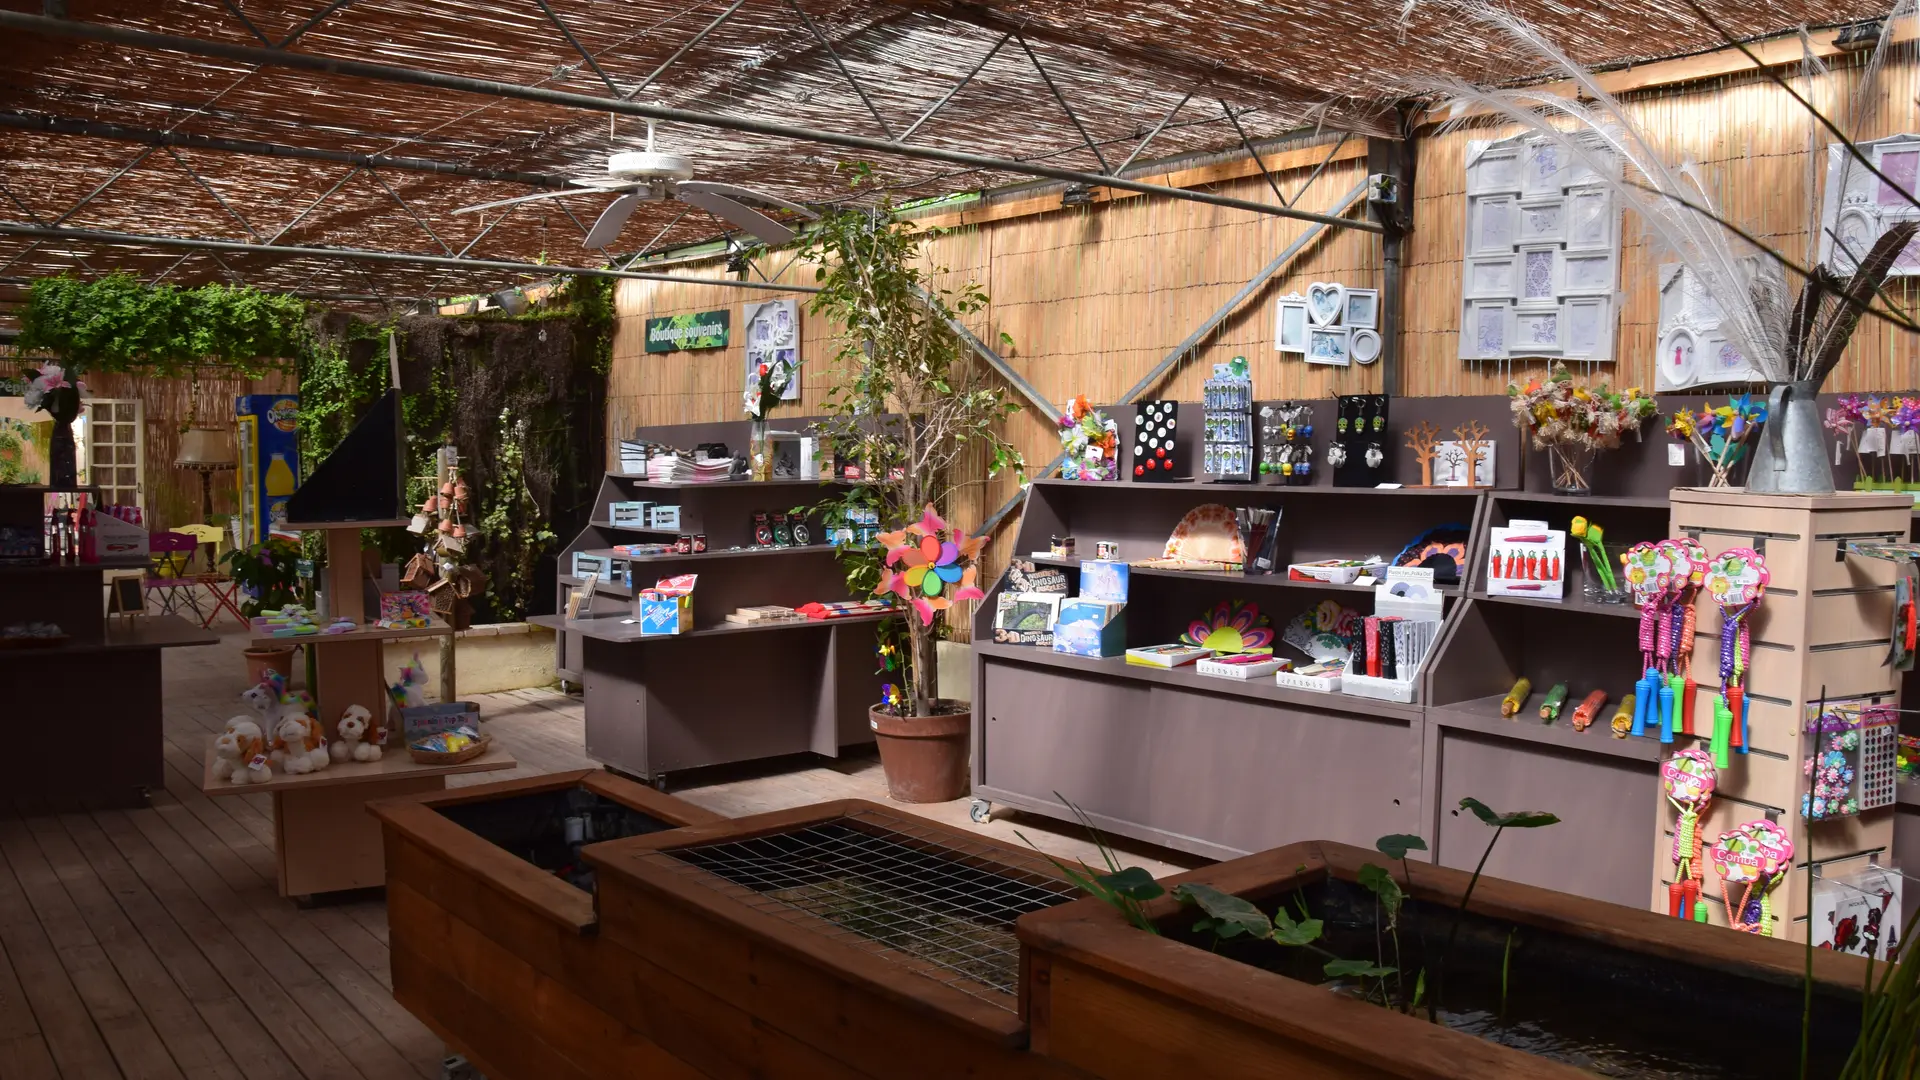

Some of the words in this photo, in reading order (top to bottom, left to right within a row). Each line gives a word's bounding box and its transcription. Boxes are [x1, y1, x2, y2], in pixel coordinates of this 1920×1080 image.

[650, 326, 683, 344] Boutique
[684, 320, 723, 338] souvenirs
[1029, 575, 1066, 587] DINOSAUR
[1020, 633, 1053, 643] DINOSAUR
[444, 716, 456, 724] Top
